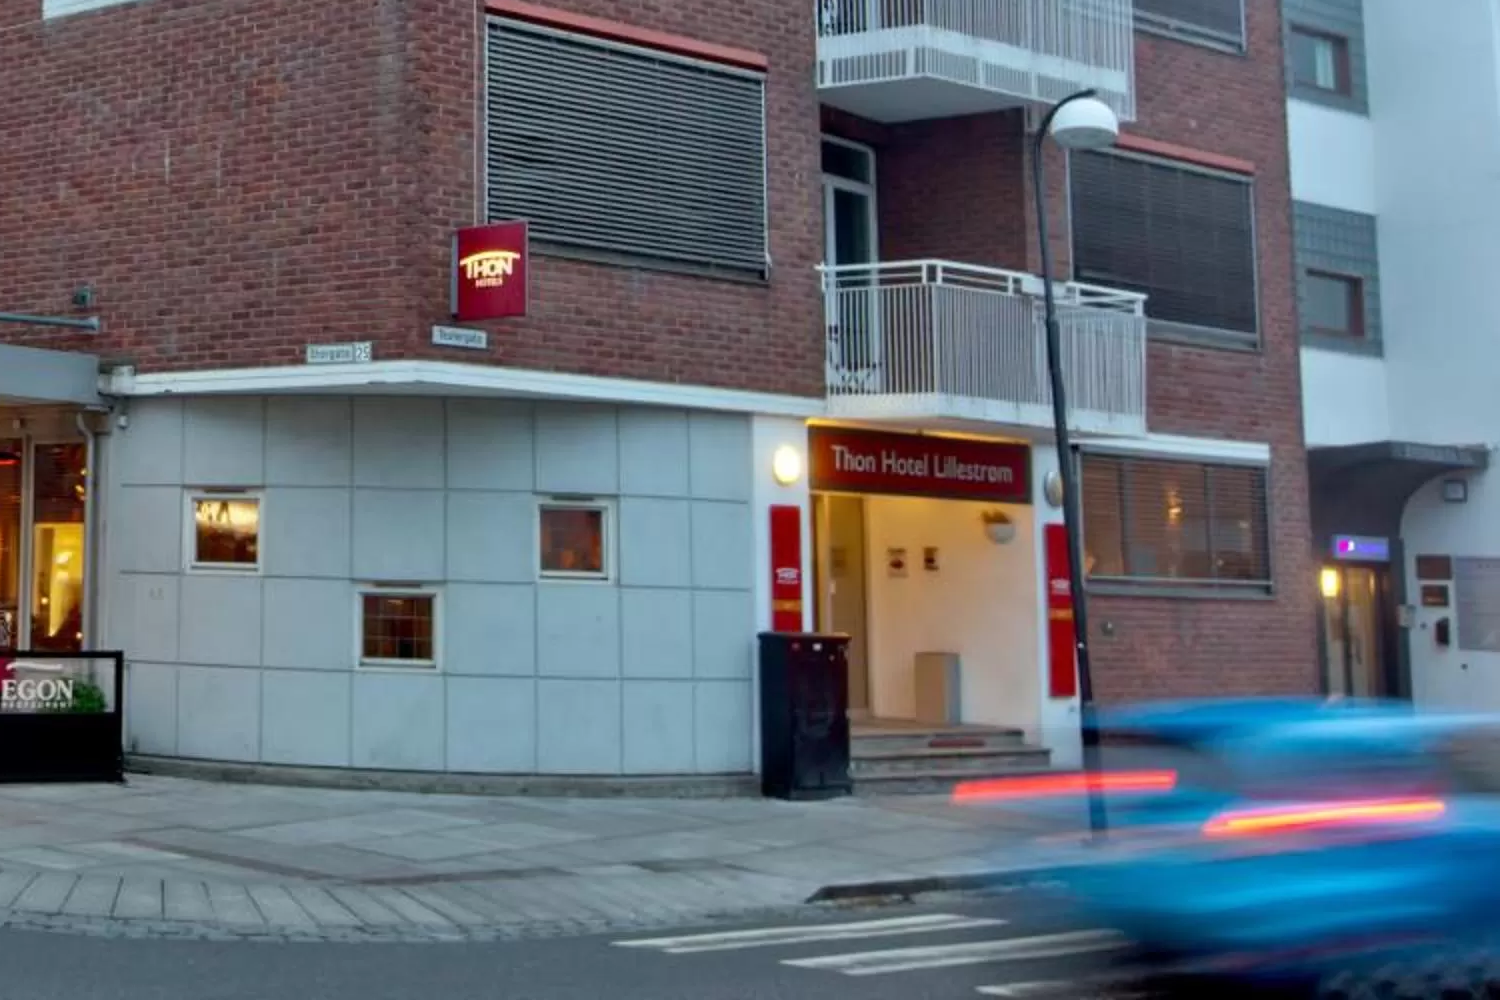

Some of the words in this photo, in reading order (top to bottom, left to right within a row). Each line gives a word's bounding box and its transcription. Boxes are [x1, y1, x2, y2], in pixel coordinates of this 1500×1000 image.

[460, 250, 521, 279] THON
[355, 346, 370, 361] 25
[831, 444, 876, 473] Thon
[882, 450, 929, 477] Hotel
[934, 453, 1013, 483] Lillestrøm
[1, 679, 74, 704] EGON
